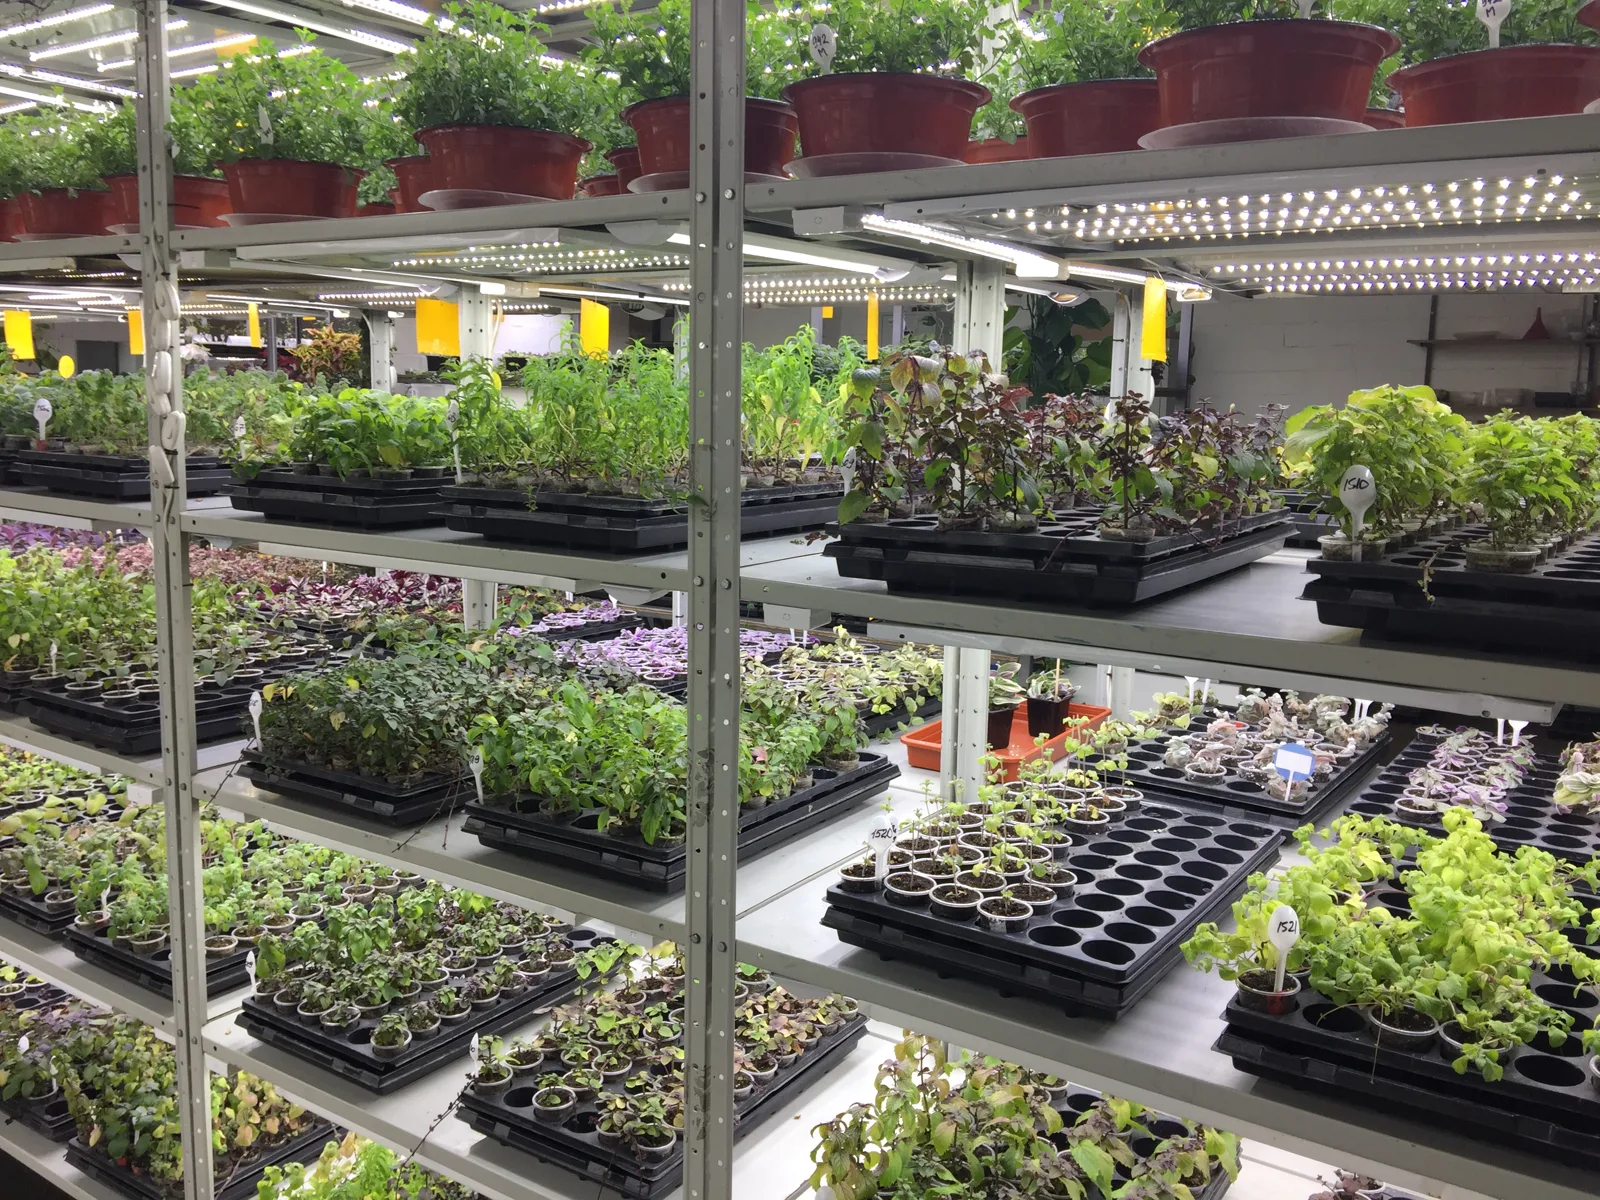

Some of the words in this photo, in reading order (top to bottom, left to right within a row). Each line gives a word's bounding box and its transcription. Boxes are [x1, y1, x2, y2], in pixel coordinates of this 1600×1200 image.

[1485, 6, 1496, 18] M
[818, 48, 828, 57] M
[1343, 477, 1370, 492] 1510
[1277, 921, 1297, 934] 1521
